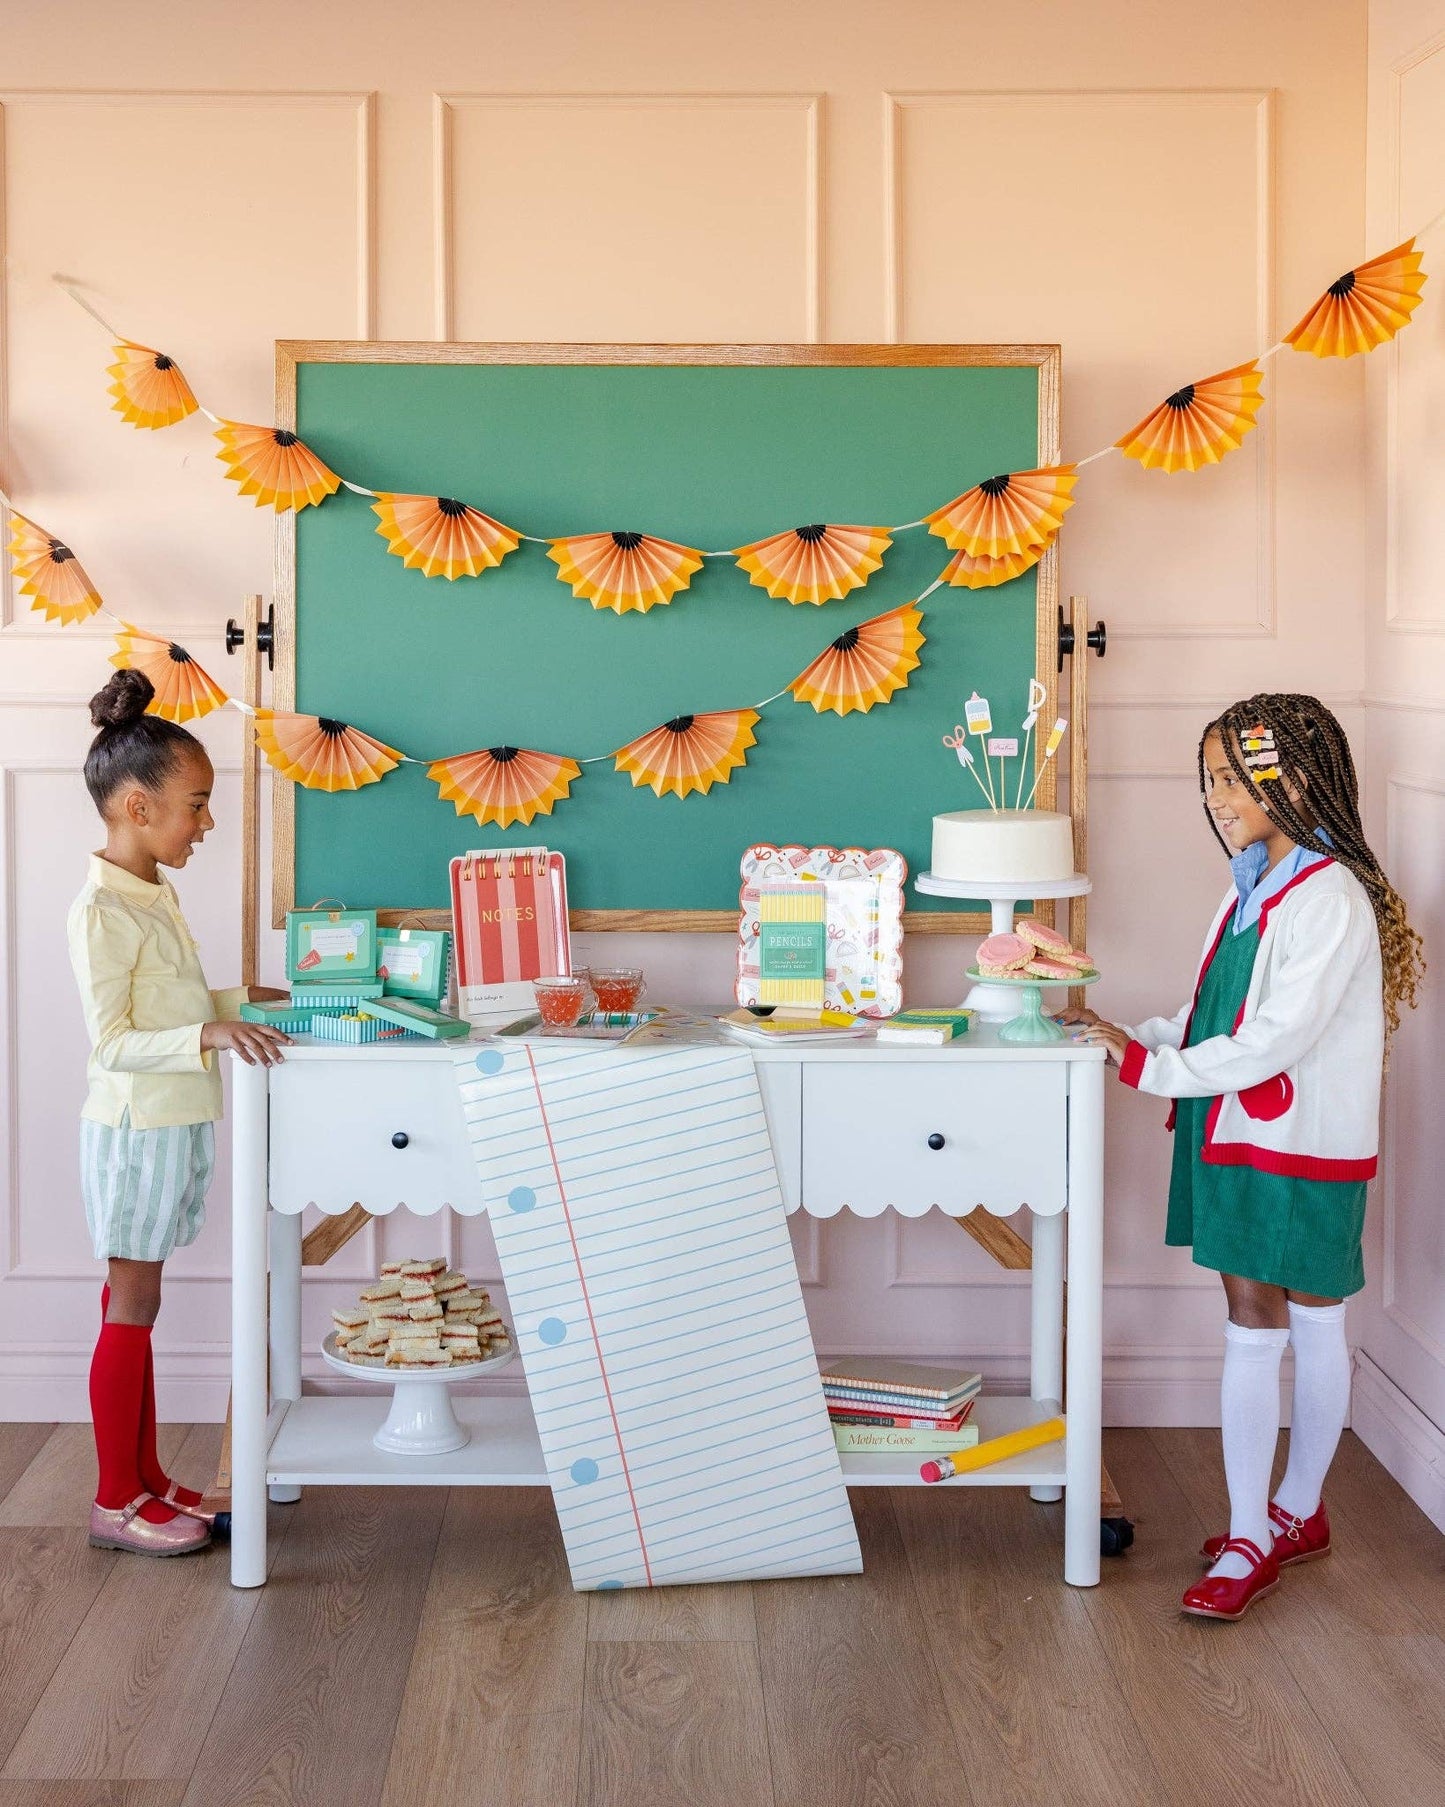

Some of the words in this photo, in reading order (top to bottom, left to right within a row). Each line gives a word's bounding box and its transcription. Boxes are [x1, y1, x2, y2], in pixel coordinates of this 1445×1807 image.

[482, 906, 535, 924] NOTES
[769, 936, 813, 947] PENCILS
[848, 1434, 885, 1445] Mother
[886, 1433, 916, 1445] Goose
